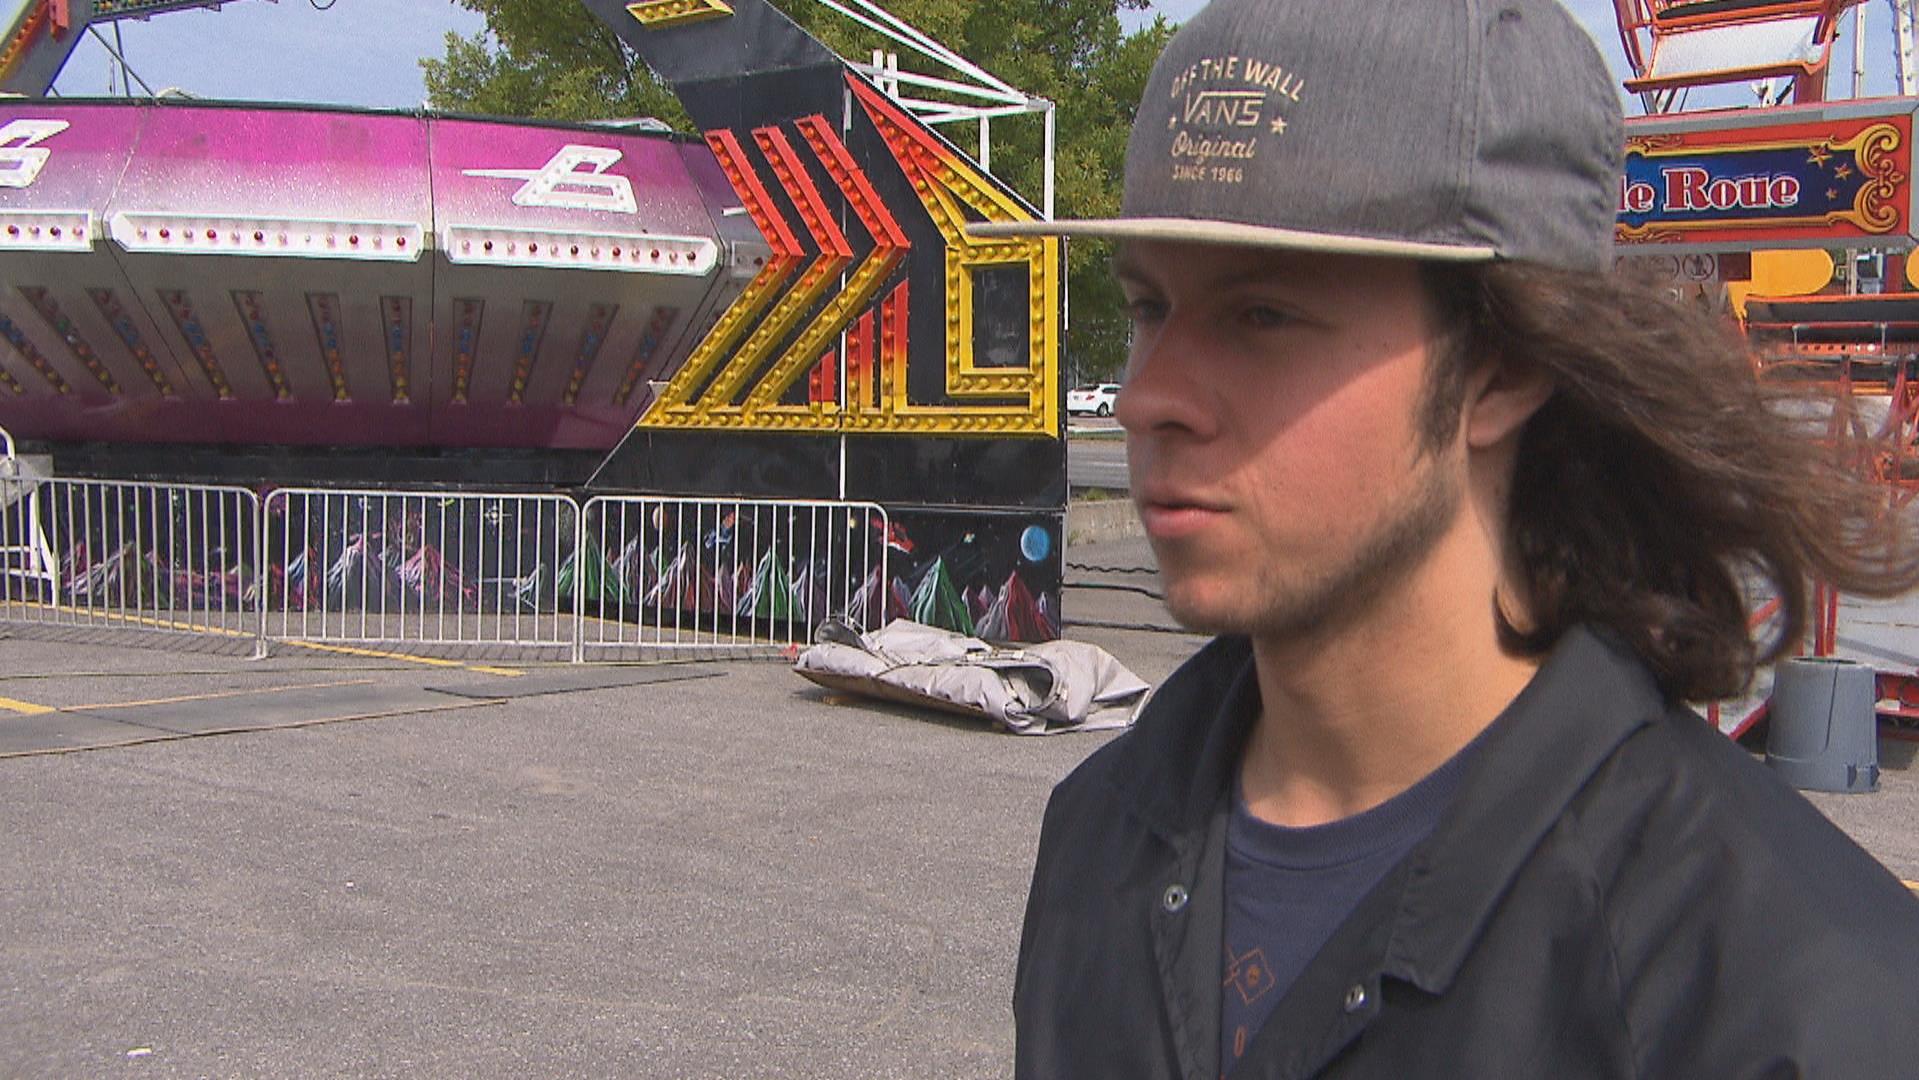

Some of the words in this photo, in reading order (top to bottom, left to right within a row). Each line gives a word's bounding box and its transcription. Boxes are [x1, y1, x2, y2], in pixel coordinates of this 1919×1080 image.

[1171, 64, 1197, 98] OFF
[1201, 57, 1238, 81] THE
[1244, 58, 1304, 102] WALL
[1184, 90, 1264, 126] VANS
[1171, 131, 1256, 164] Original
[1172, 165, 1206, 181] SINCE
[1211, 167, 1243, 183] 1966
[1662, 168, 1800, 211] Roue
